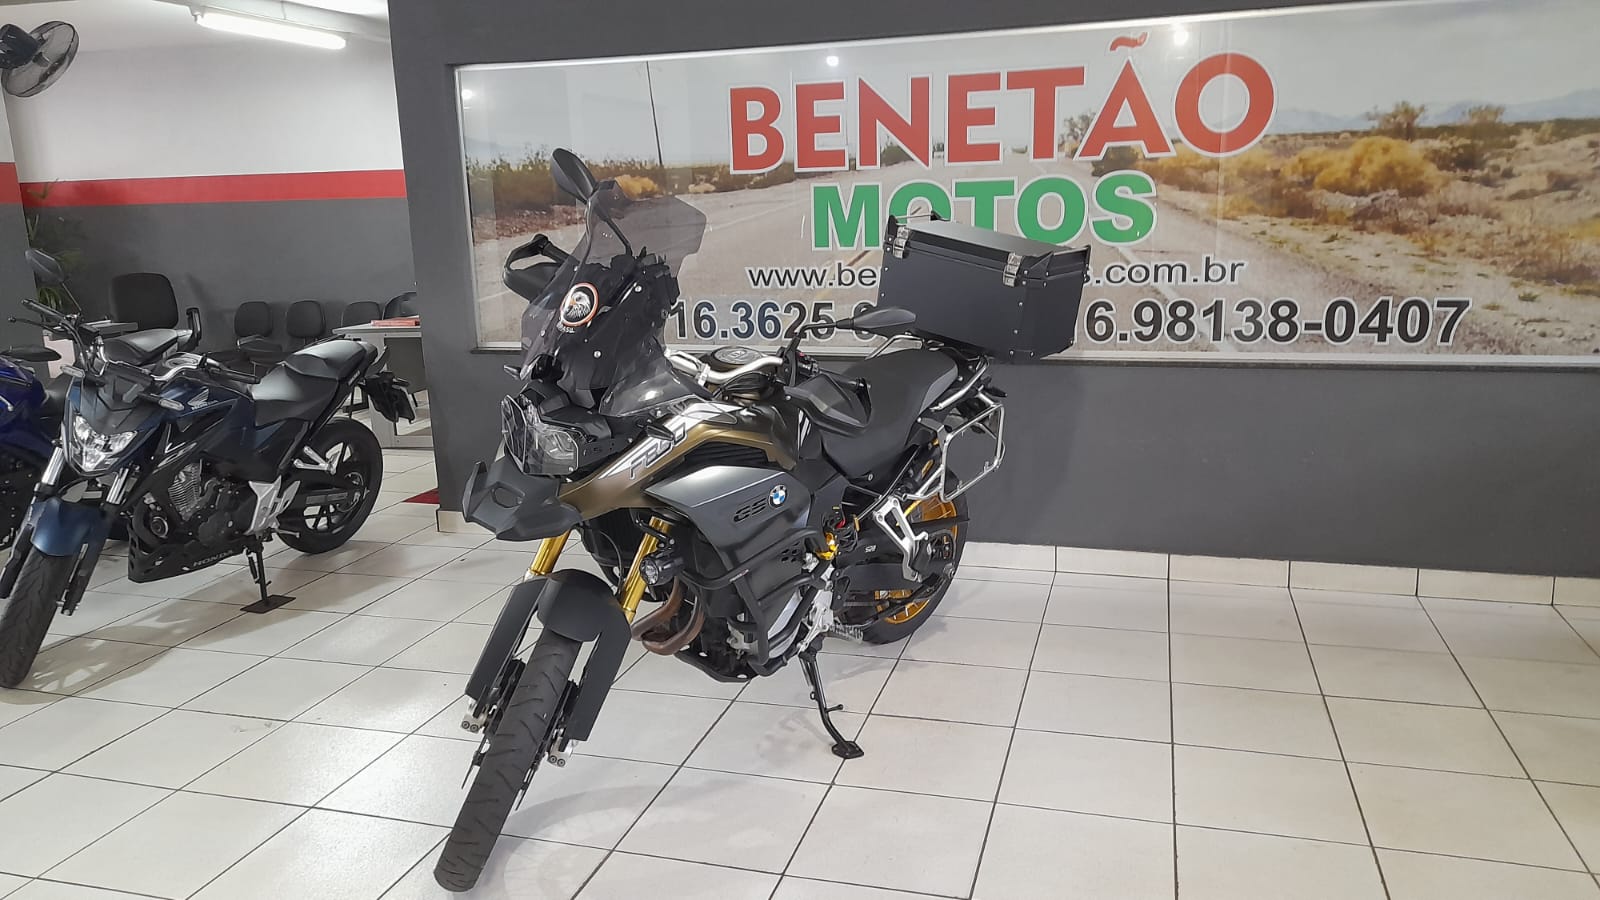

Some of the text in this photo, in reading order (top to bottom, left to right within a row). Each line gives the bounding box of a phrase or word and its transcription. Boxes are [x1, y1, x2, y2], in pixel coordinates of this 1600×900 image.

[729, 32, 1275, 173] BENETÃO
[813, 172, 1156, 249] MOTOS
[1085, 298, 1470, 343] 6.98138-0407
